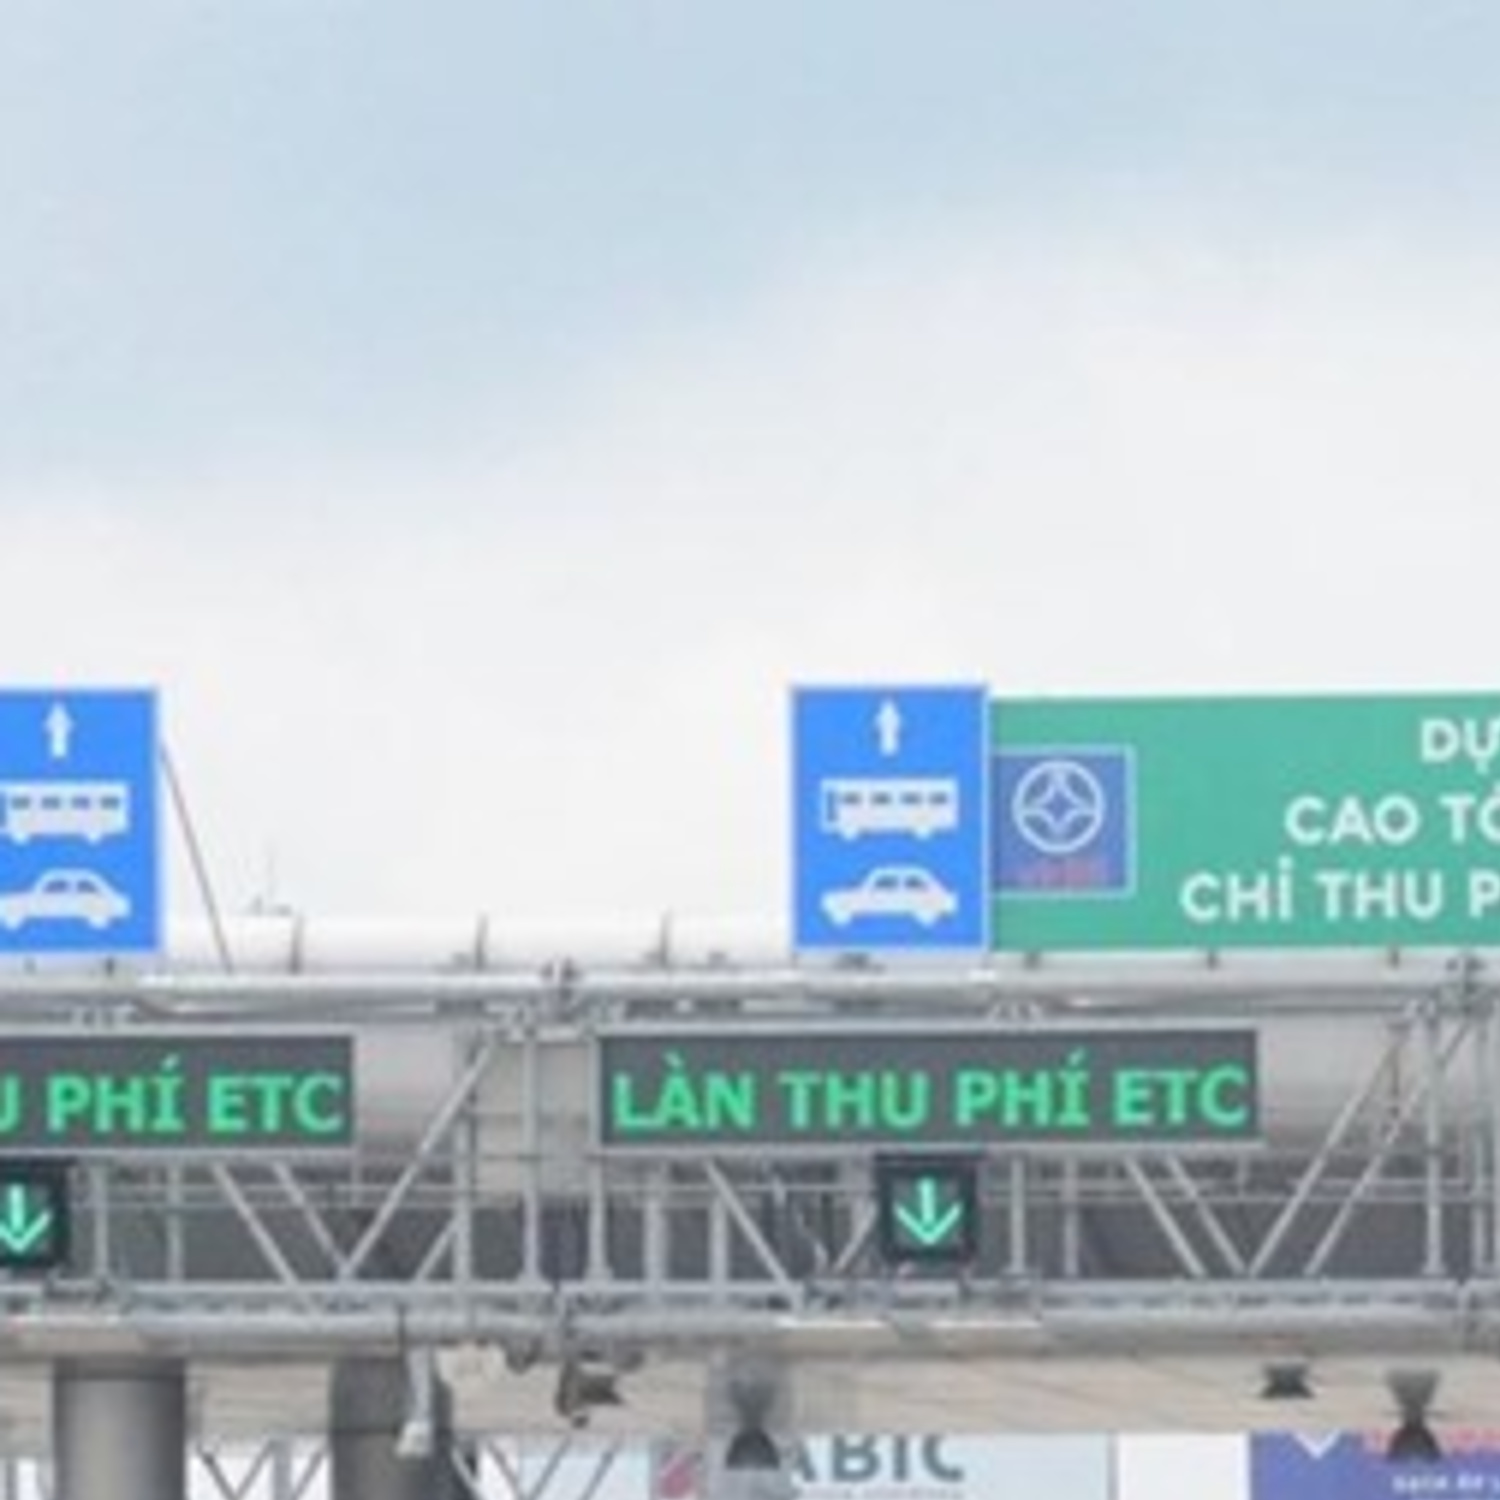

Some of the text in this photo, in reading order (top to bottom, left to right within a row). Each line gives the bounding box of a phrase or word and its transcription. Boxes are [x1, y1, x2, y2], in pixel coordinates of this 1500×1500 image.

[1284, 795, 1421, 846] CAO
[1178, 854, 1293, 921] CHỈ
[1315, 869, 1446, 920] THU
[47, 1053, 186, 1133] PHÍ
[207, 1073, 346, 1133] ETC
[612, 1048, 1251, 1131] LÀN THU PHÍ ETC
